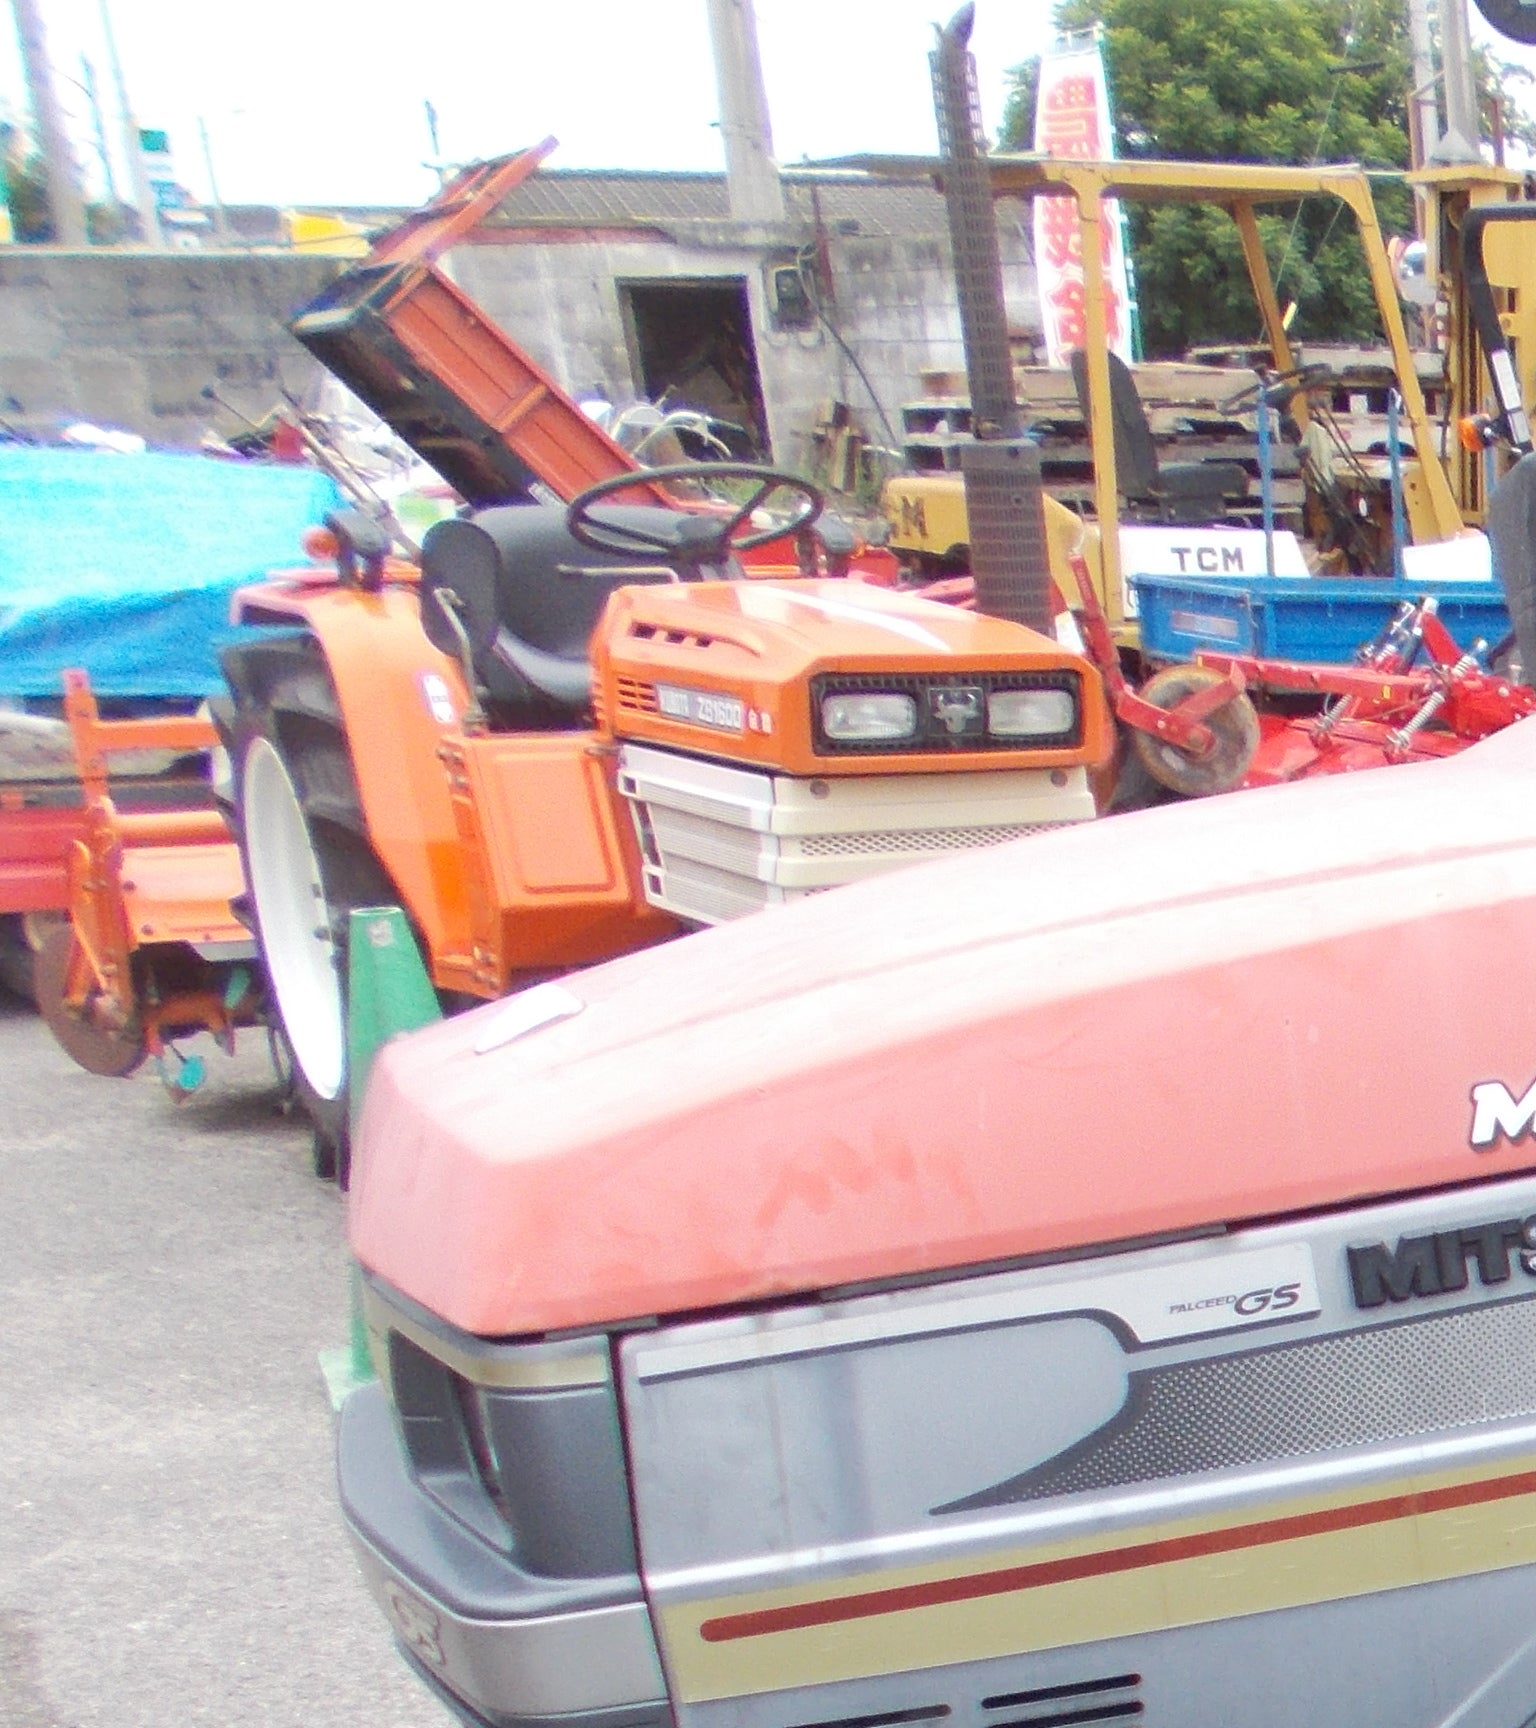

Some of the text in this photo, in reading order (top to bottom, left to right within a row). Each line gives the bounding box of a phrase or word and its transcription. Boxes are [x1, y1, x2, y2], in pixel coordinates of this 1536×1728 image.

[1170, 546, 1245, 573] TCM
[1169, 1282, 1301, 1316] PALCEED GS
